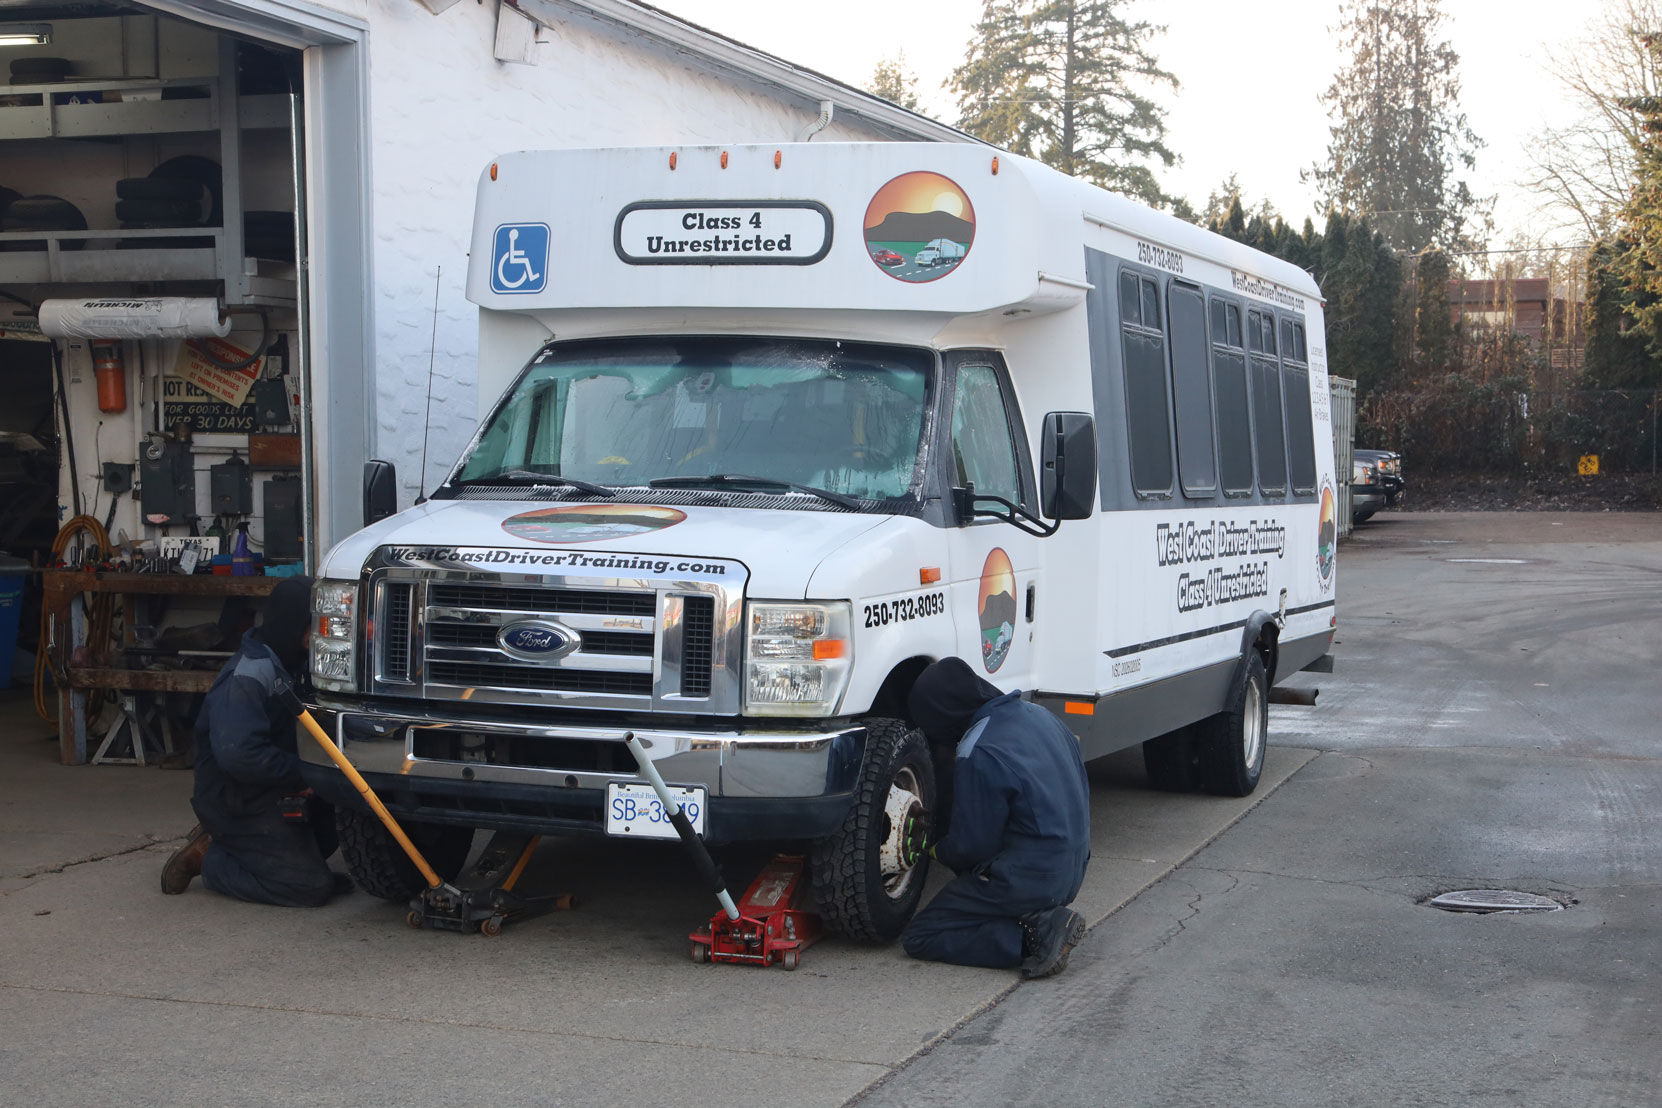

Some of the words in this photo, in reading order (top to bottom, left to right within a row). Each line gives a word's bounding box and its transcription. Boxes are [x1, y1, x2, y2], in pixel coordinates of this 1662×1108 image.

[682, 212, 741, 230] Class
[749, 212, 762, 229] 4
[647, 234, 792, 253] Unrestricted
[1137, 241, 1184, 274] 250-732-8093
[1231, 270, 1305, 311] WestCoastDriverTraining.com
[212, 370, 240, 392] PREMISES
[222, 387, 236, 400] RISK
[188, 404, 220, 415] GOODS
[196, 415, 215, 429] 30
[217, 416, 254, 429] DAYS
[1157, 522, 1184, 567] West
[1185, 520, 1215, 563] Coast
[1218, 520, 1248, 557] Driver
[1249, 519, 1285, 559] Training
[389, 547, 726, 575] WestCoastDriverTraining.com
[1177, 572, 1205, 613] Class
[1205, 569, 1213, 607] 4
[1213, 561, 1268, 606] Unrestricted
[864, 592, 944, 628] 250-732-8093
[516, 630, 552, 648] Ford
[617, 791, 644, 799] Beautiful
[612, 798, 637, 821] SB
